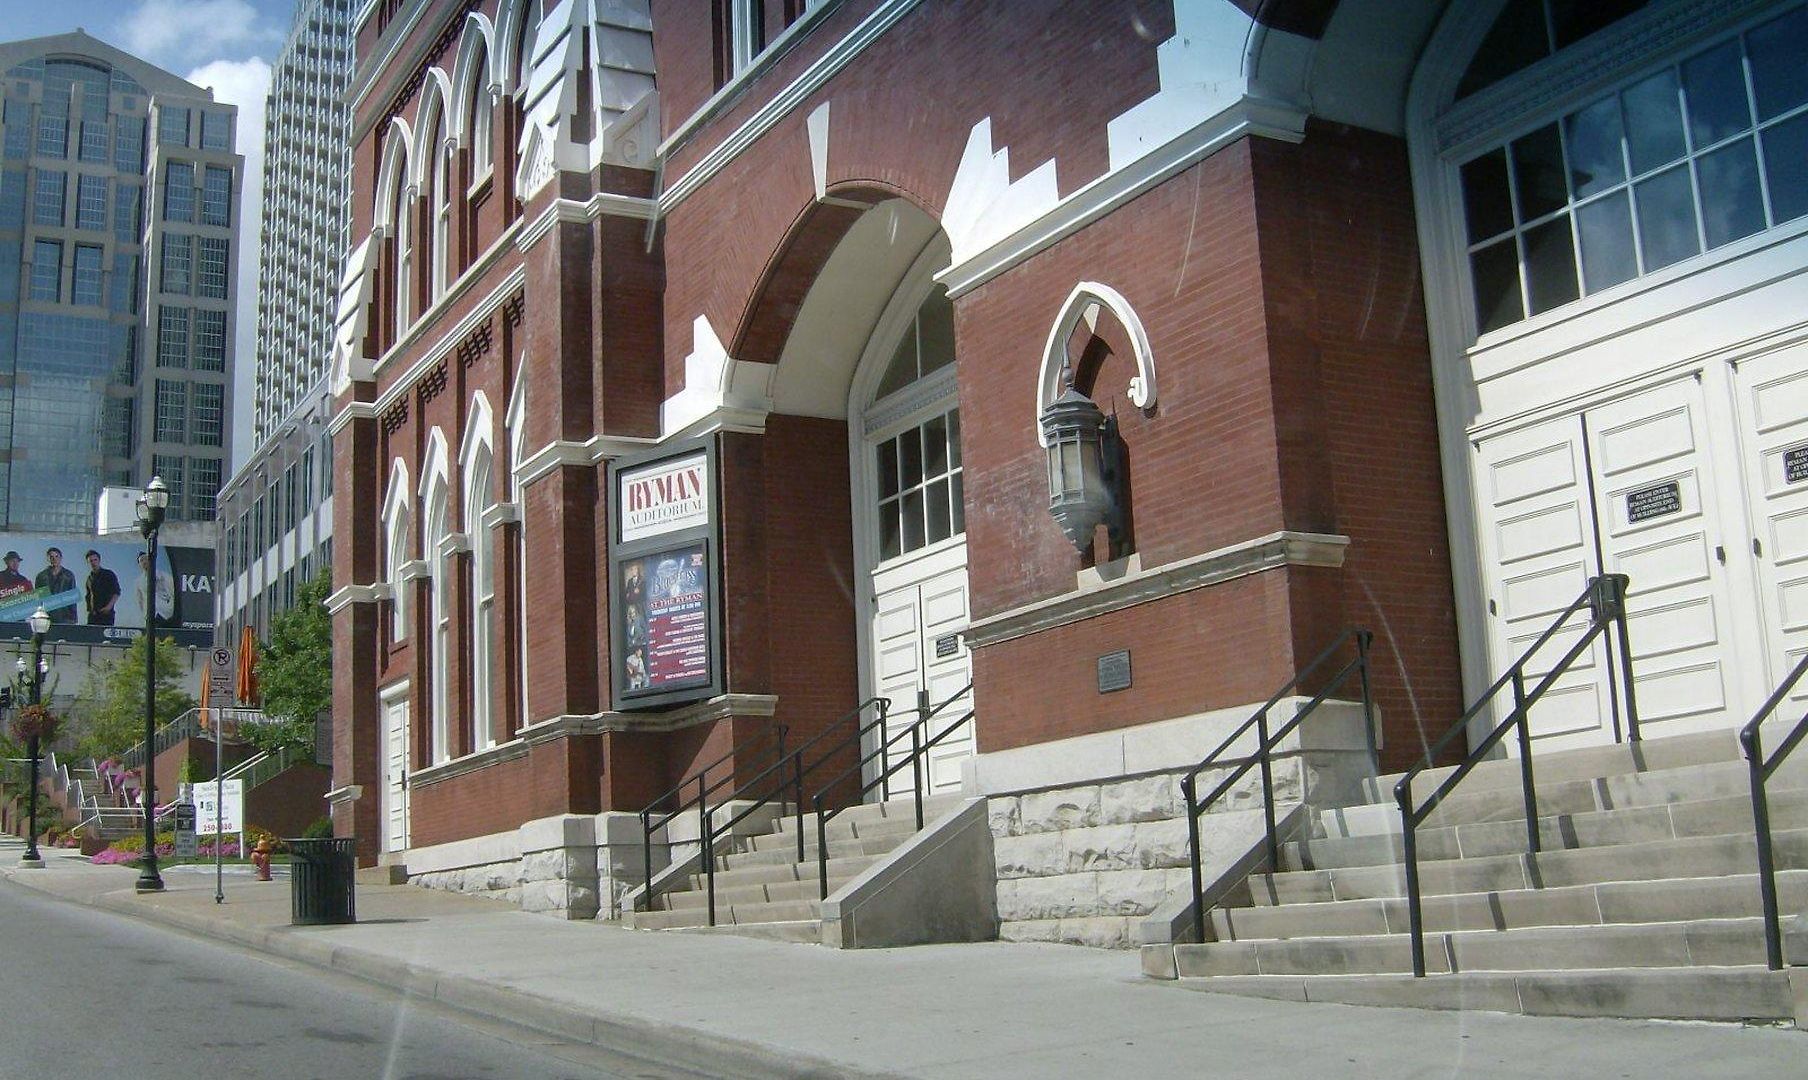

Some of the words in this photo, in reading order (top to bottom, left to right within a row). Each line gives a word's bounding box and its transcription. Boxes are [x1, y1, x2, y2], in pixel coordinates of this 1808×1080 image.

[628, 468, 701, 512] RYMAN
[631, 500, 704, 525] AUDITORIUM
[182, 575, 215, 593] KA
